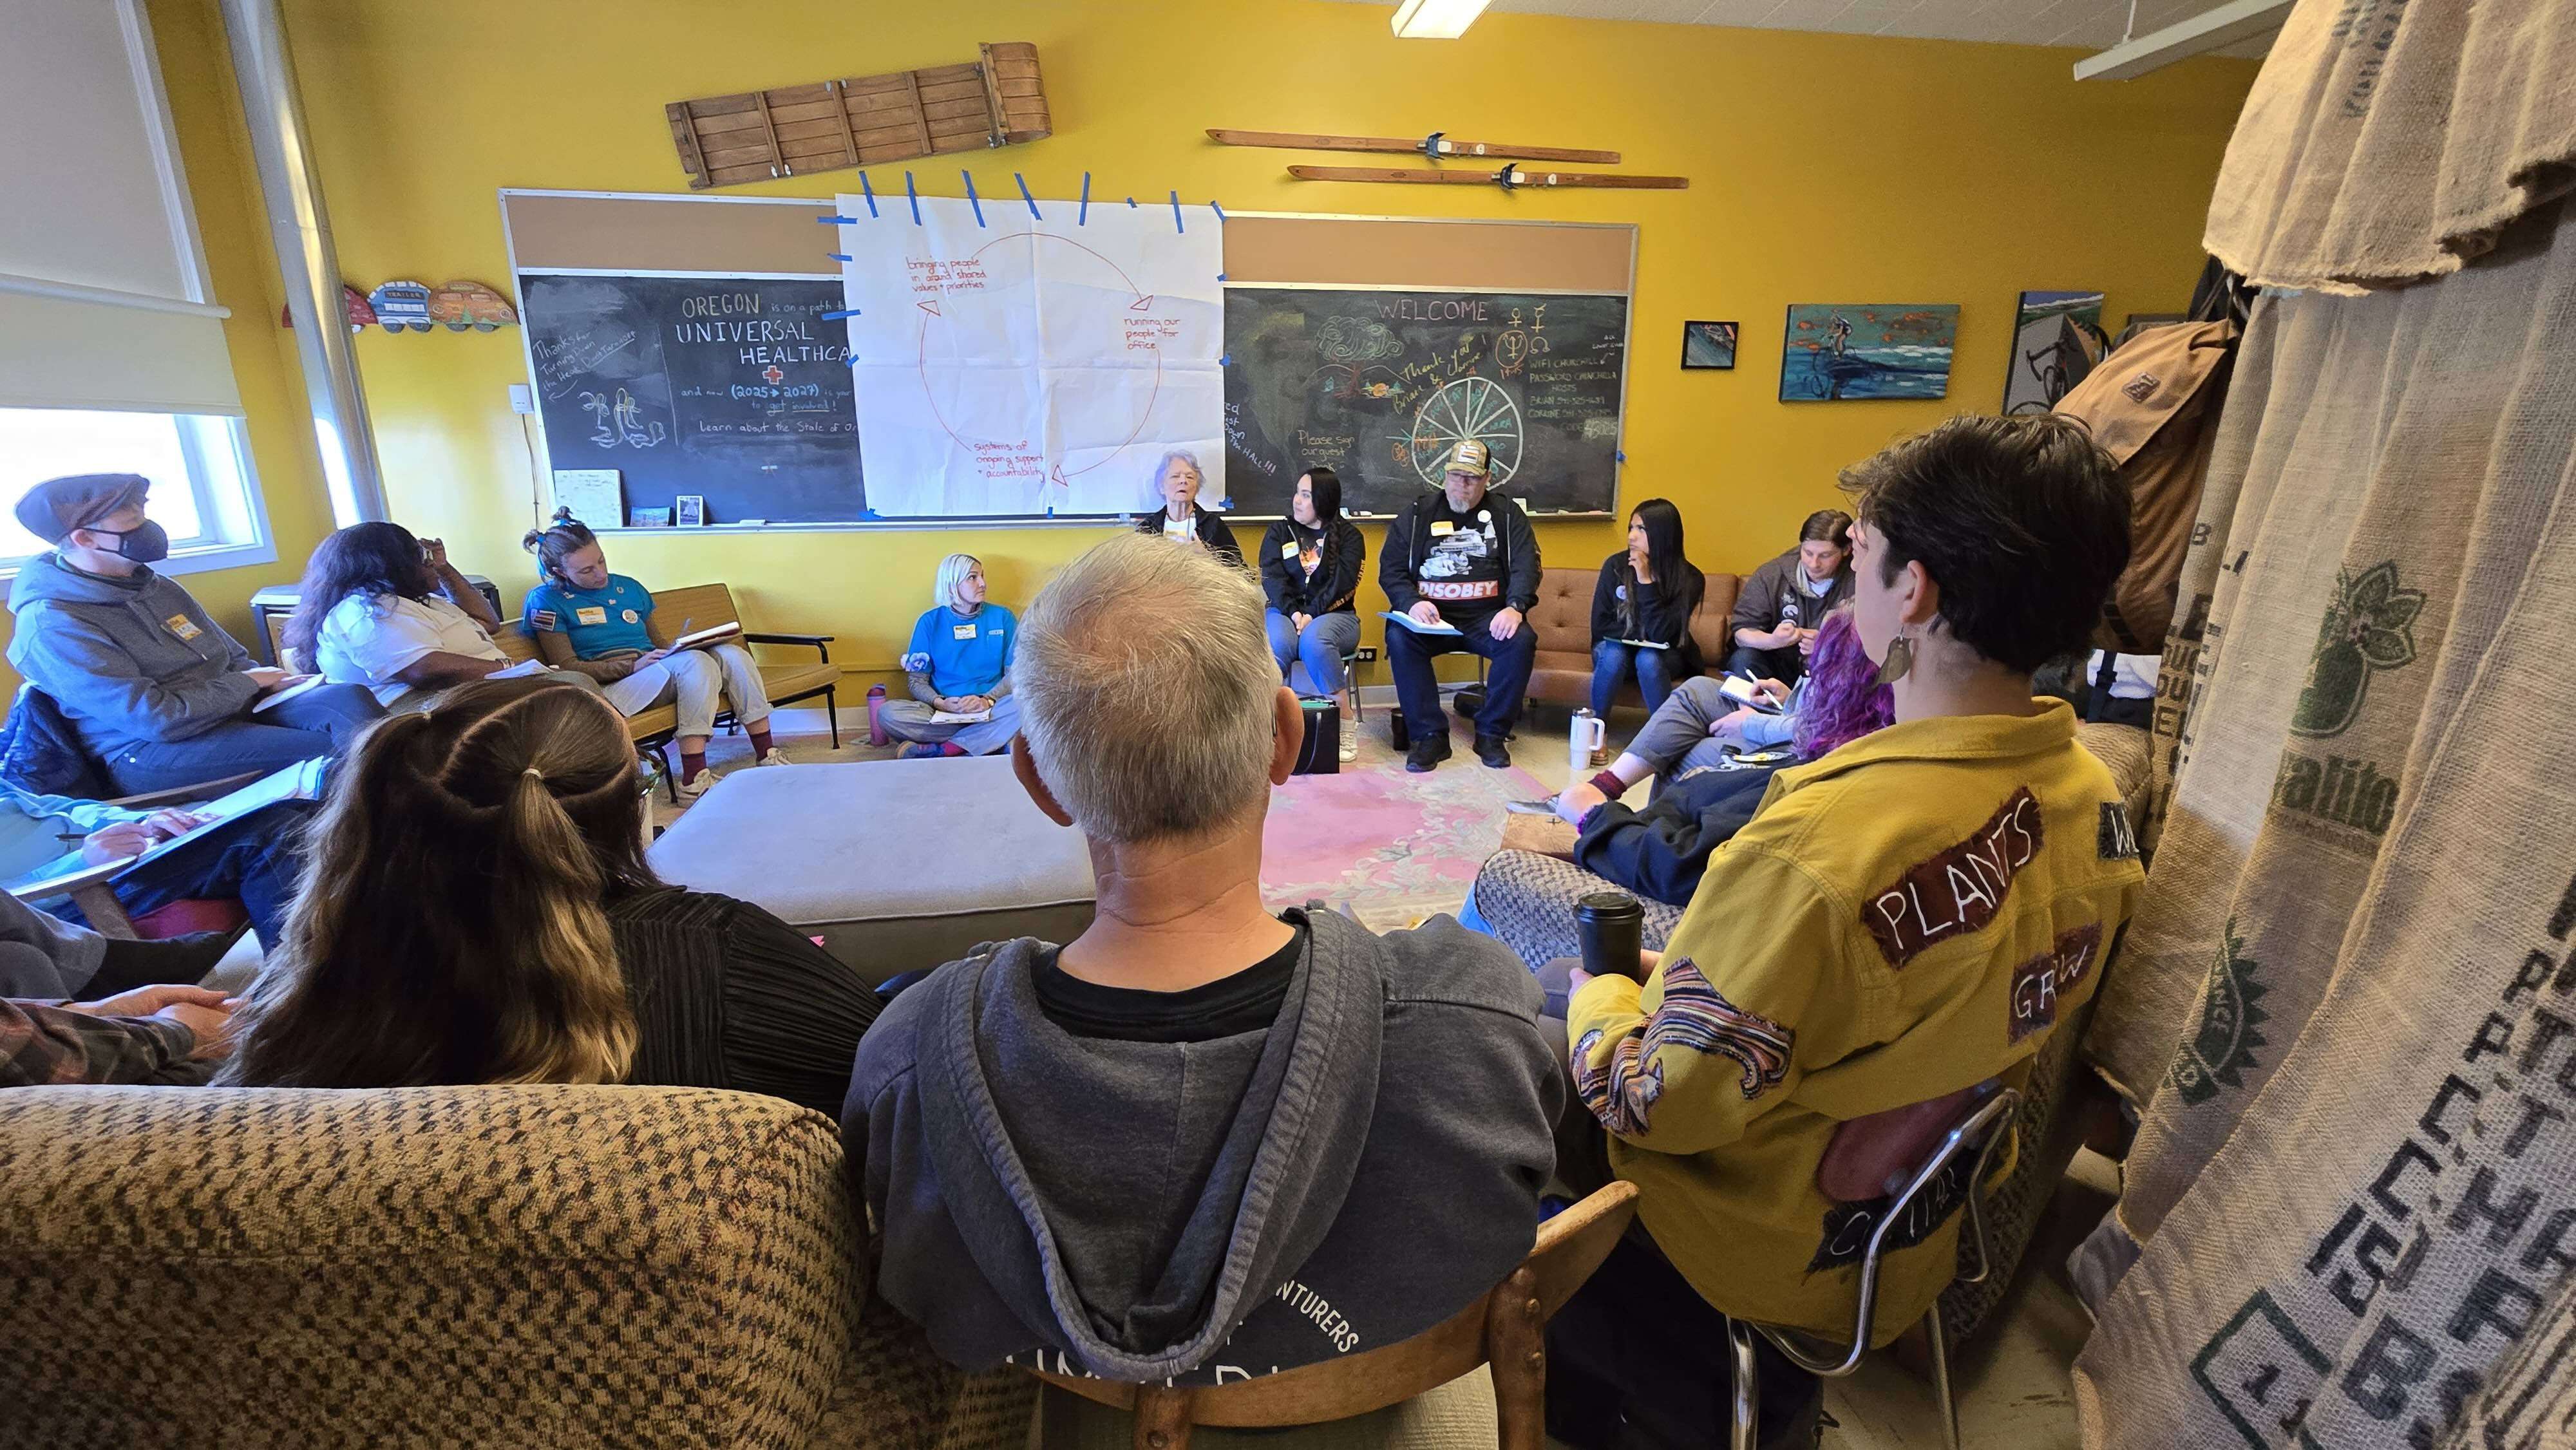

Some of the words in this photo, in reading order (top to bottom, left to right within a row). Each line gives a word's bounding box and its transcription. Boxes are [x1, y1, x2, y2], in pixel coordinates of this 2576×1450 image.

[905, 255, 949, 274] bringing
[950, 259, 981, 273] people
[909, 271, 921, 282] in
[925, 273, 953, 281] around
[957, 268, 987, 279] shared
[911, 283, 938, 292] values
[945, 279, 985, 295] priorities
[682, 294, 759, 318] OREGON
[772, 303, 780, 312] is
[784, 304, 796, 312] on
[809, 300, 831, 315] path
[1374, 299, 1488, 321] WELCOME
[676, 319, 815, 343] UNIVERSAL
[1123, 316, 1163, 332] running
[1125, 328, 1155, 341] people
[1162, 327, 1179, 337] for
[533, 334, 576, 359] Thanks
[1127, 340, 1157, 350] office
[739, 345, 851, 365] HEALTHCA
[540, 355, 576, 376] Turning
[681, 386, 702, 397] and
[700, 420, 732, 432] Learn
[739, 421, 770, 432] about
[775, 420, 790, 431] the
[829, 422, 840, 433] of
[973, 441, 1013, 456] systems
[1015, 440, 1028, 451] of
[1298, 429, 1334, 445] Please
[1335, 436, 1356, 449] sign
[976, 456, 1015, 469] ongoing
[1014, 453, 1044, 466] support
[1302, 447, 1318, 456] our
[1318, 447, 1346, 462] guest
[986, 466, 1046, 484] accountability
[1419, 580, 1498, 598] DISOBEY
[1876, 796, 2032, 950] PLANTS
[1274, 1279, 1359, 1353] NTURERS
